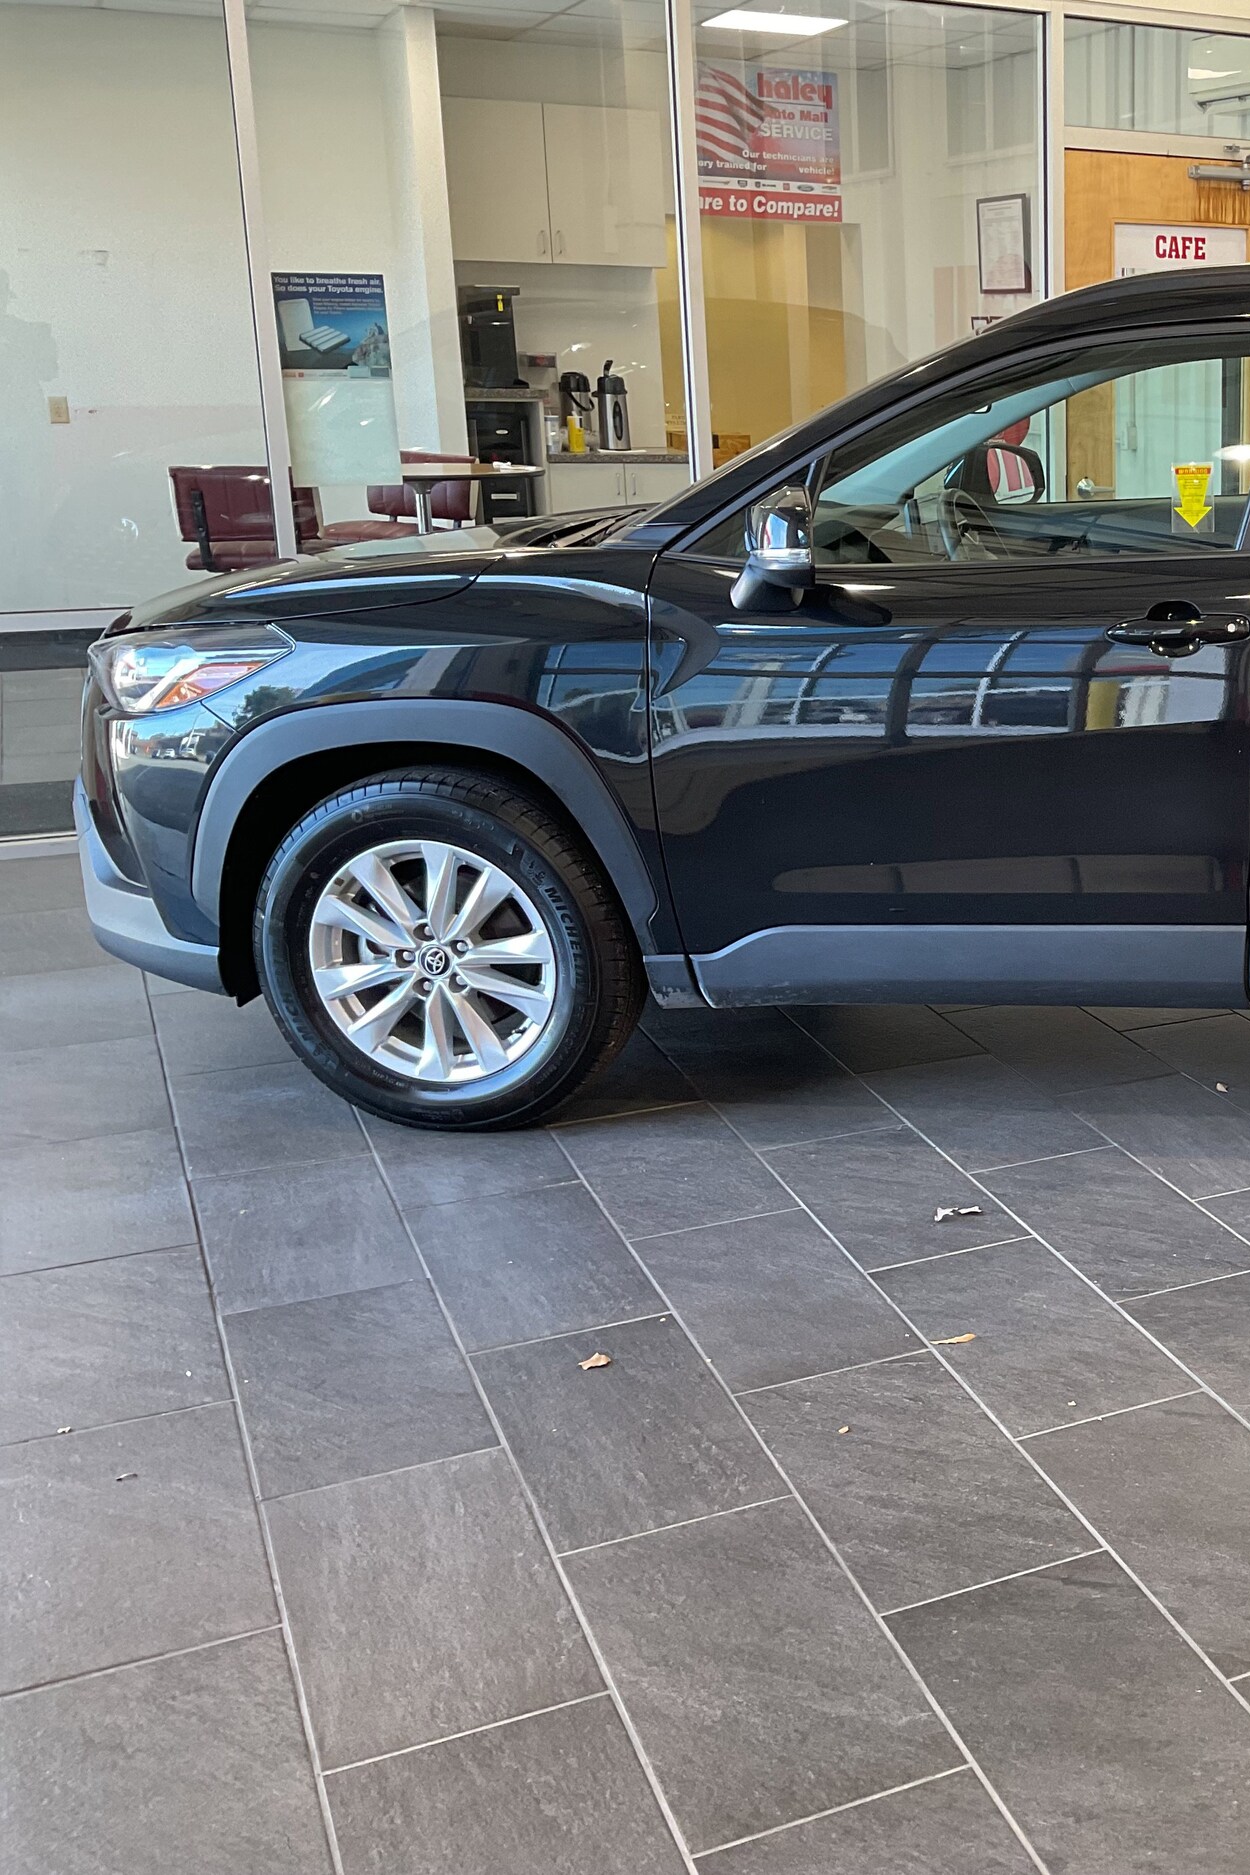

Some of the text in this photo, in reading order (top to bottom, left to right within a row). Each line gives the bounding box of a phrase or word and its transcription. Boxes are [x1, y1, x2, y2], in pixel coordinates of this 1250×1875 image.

[756, 72, 833, 110] haley
[800, 110, 829, 123] Mall
[759, 123, 833, 141] SERVICE
[742, 149, 760, 159] Our
[762, 151, 817, 163] technicians
[716, 160, 750, 170] trained
[751, 162, 767, 172] for
[798, 166, 835, 176] vehicle!
[729, 194, 748, 212] to
[753, 195, 839, 218] Compare!
[1155, 234, 1206, 260] CAFE
[274, 276, 288, 284] You
[290, 276, 305, 284] like
[316, 277, 346, 285] breathe
[348, 277, 368, 285] fresh
[275, 284, 286, 292] So
[308, 286, 326, 294] your
[327, 285, 353, 294] Toyota
